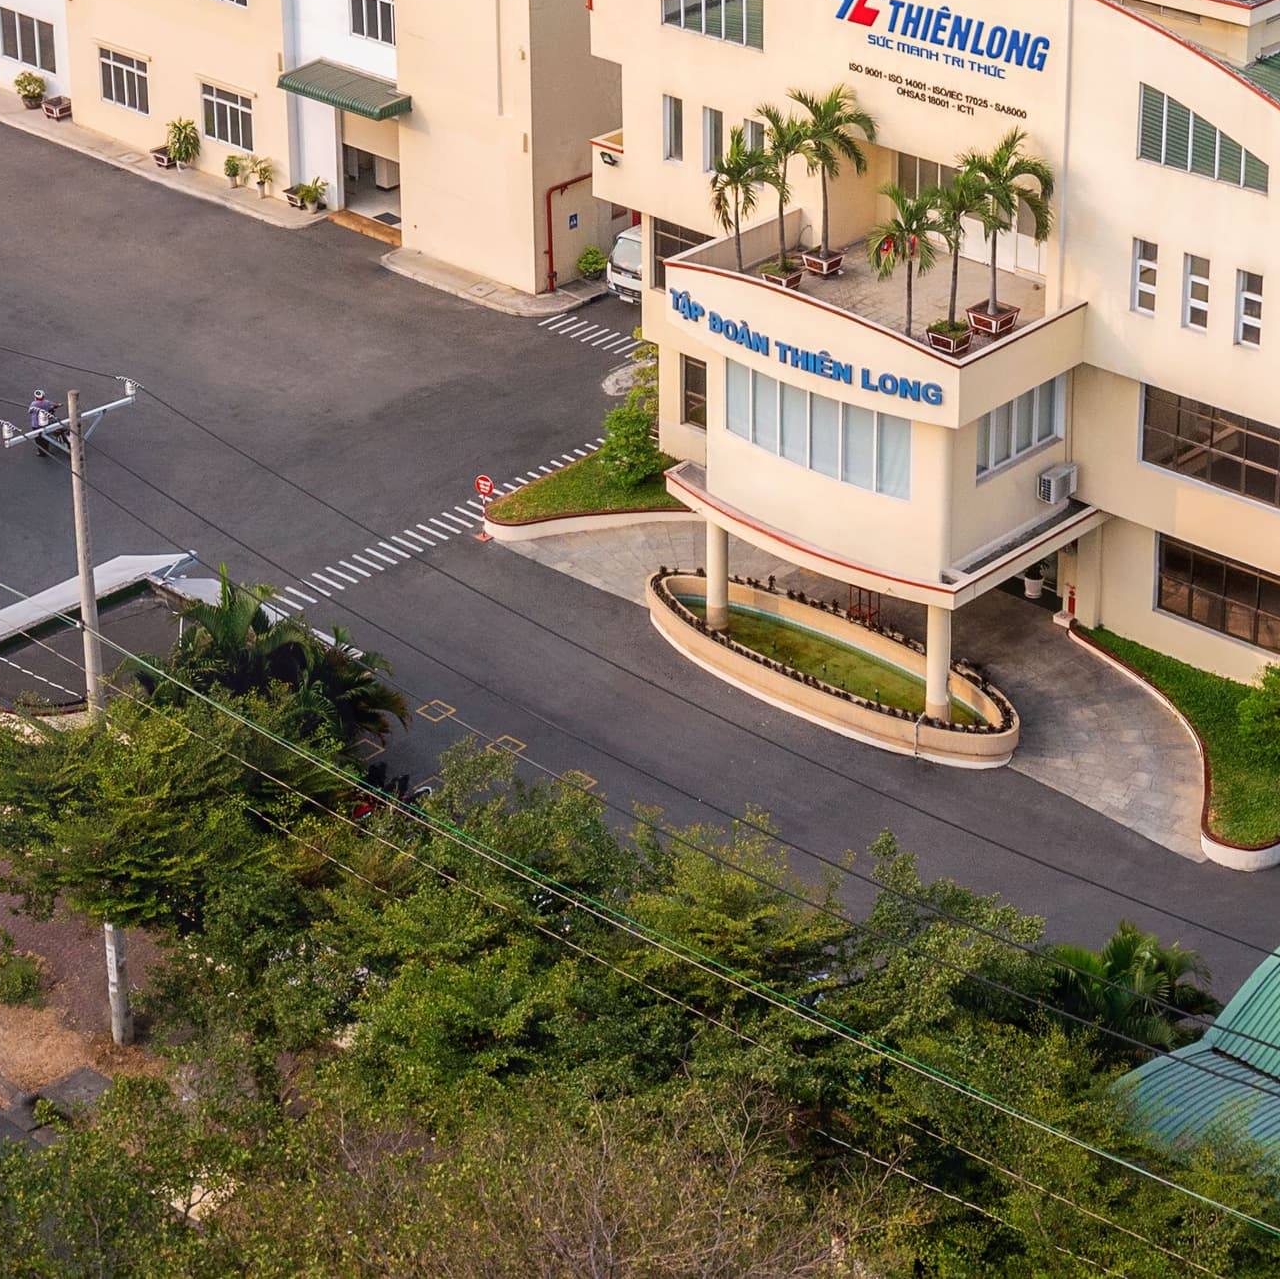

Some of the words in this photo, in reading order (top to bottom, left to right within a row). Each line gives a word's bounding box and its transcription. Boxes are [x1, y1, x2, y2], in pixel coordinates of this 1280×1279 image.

[943, 53, 965, 69] TRI
[849, 62, 863, 73] ISO
[865, 67, 882, 79] 9001
[888, 73, 903, 84] ISO
[905, 78, 926, 91] 14001
[932, 85, 963, 102] ISO/IEC
[965, 95, 988, 109] 17025
[994, 103, 1027, 119] SA8000
[896, 87, 926, 102] OHSAS
[927, 95, 949, 108] 18001
[957, 104, 974, 116] ICTI
[669, 288, 704, 322] TẬP
[708, 310, 769, 356] ĐOÀN
[774, 340, 852, 385] THIÊN
[861, 369, 943, 405] LONG
